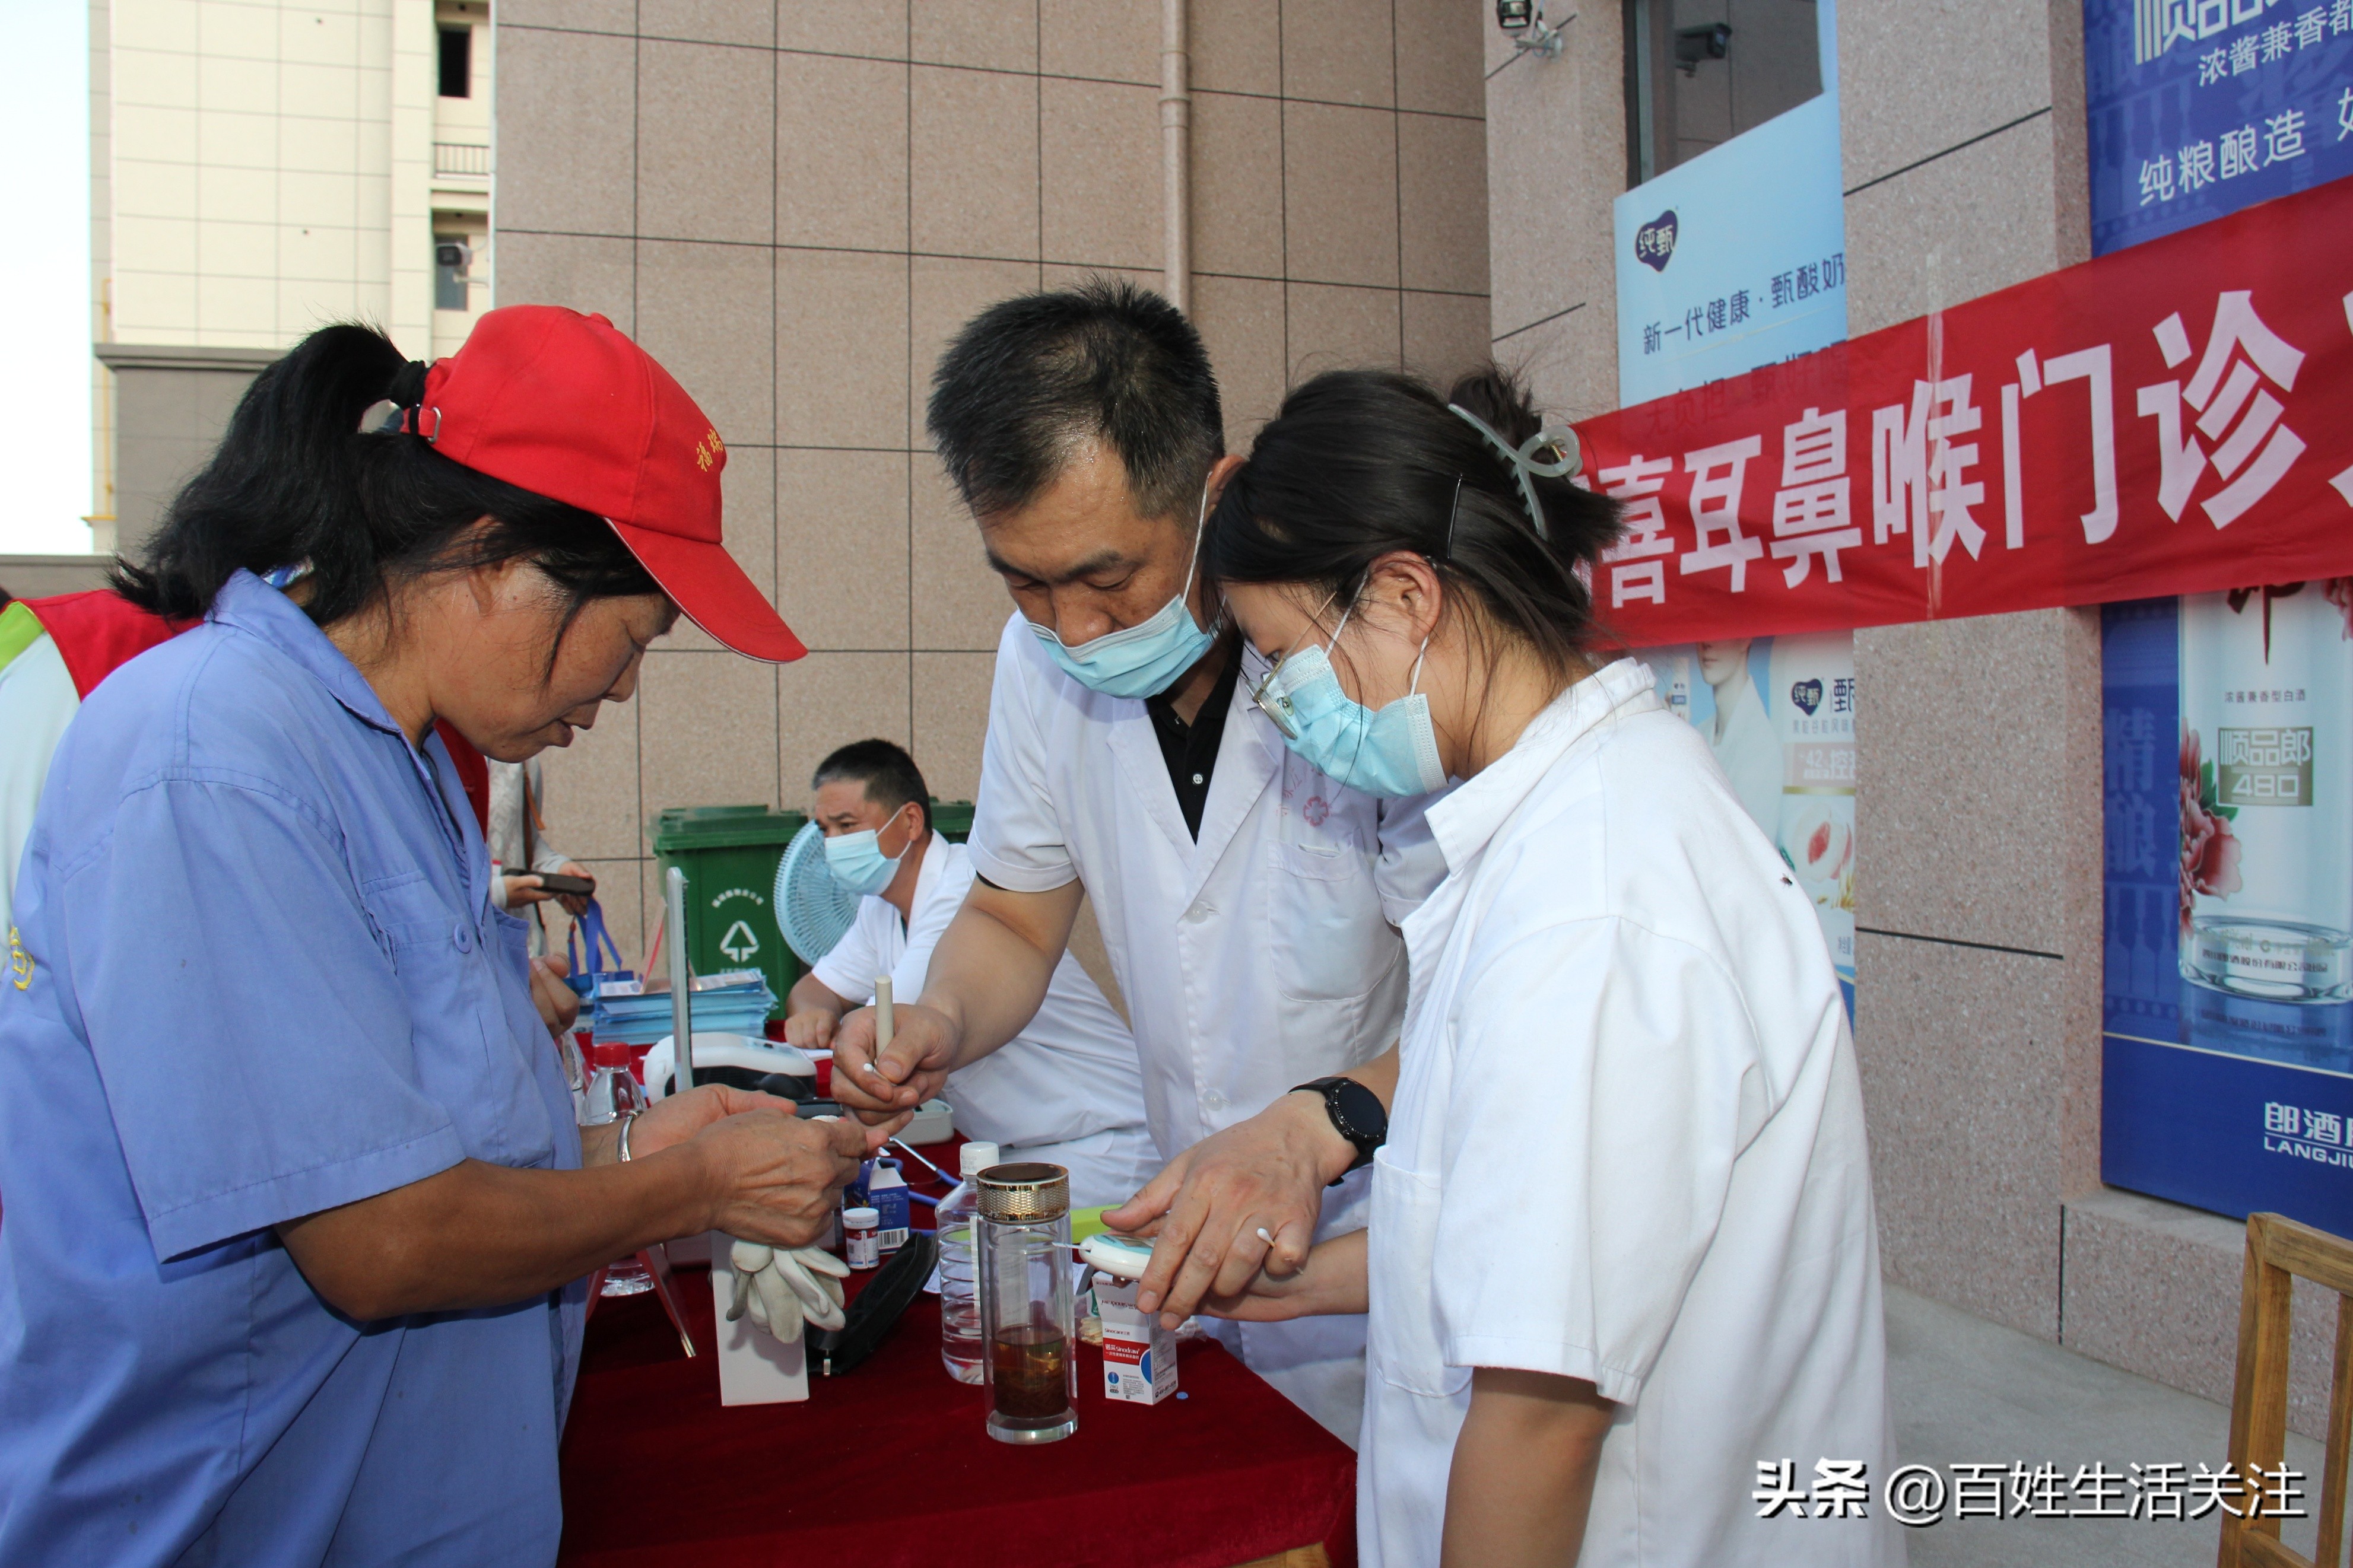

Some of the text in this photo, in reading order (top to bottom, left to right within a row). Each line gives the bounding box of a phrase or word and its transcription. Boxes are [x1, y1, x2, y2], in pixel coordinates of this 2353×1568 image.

[2138, 109, 2306, 206] 纯粮酿造
[1638, 225, 1674, 258] 纯甄
[1570, 290, 2353, 609] 喜耳鼻喉门诊
[2224, 688, 2306, 704] 浓酱兼香型白酒
[2219, 729, 2311, 766] 顺品郎
[2231, 774, 2299, 797] 480
[2263, 1101, 2353, 1147] 郎酒
